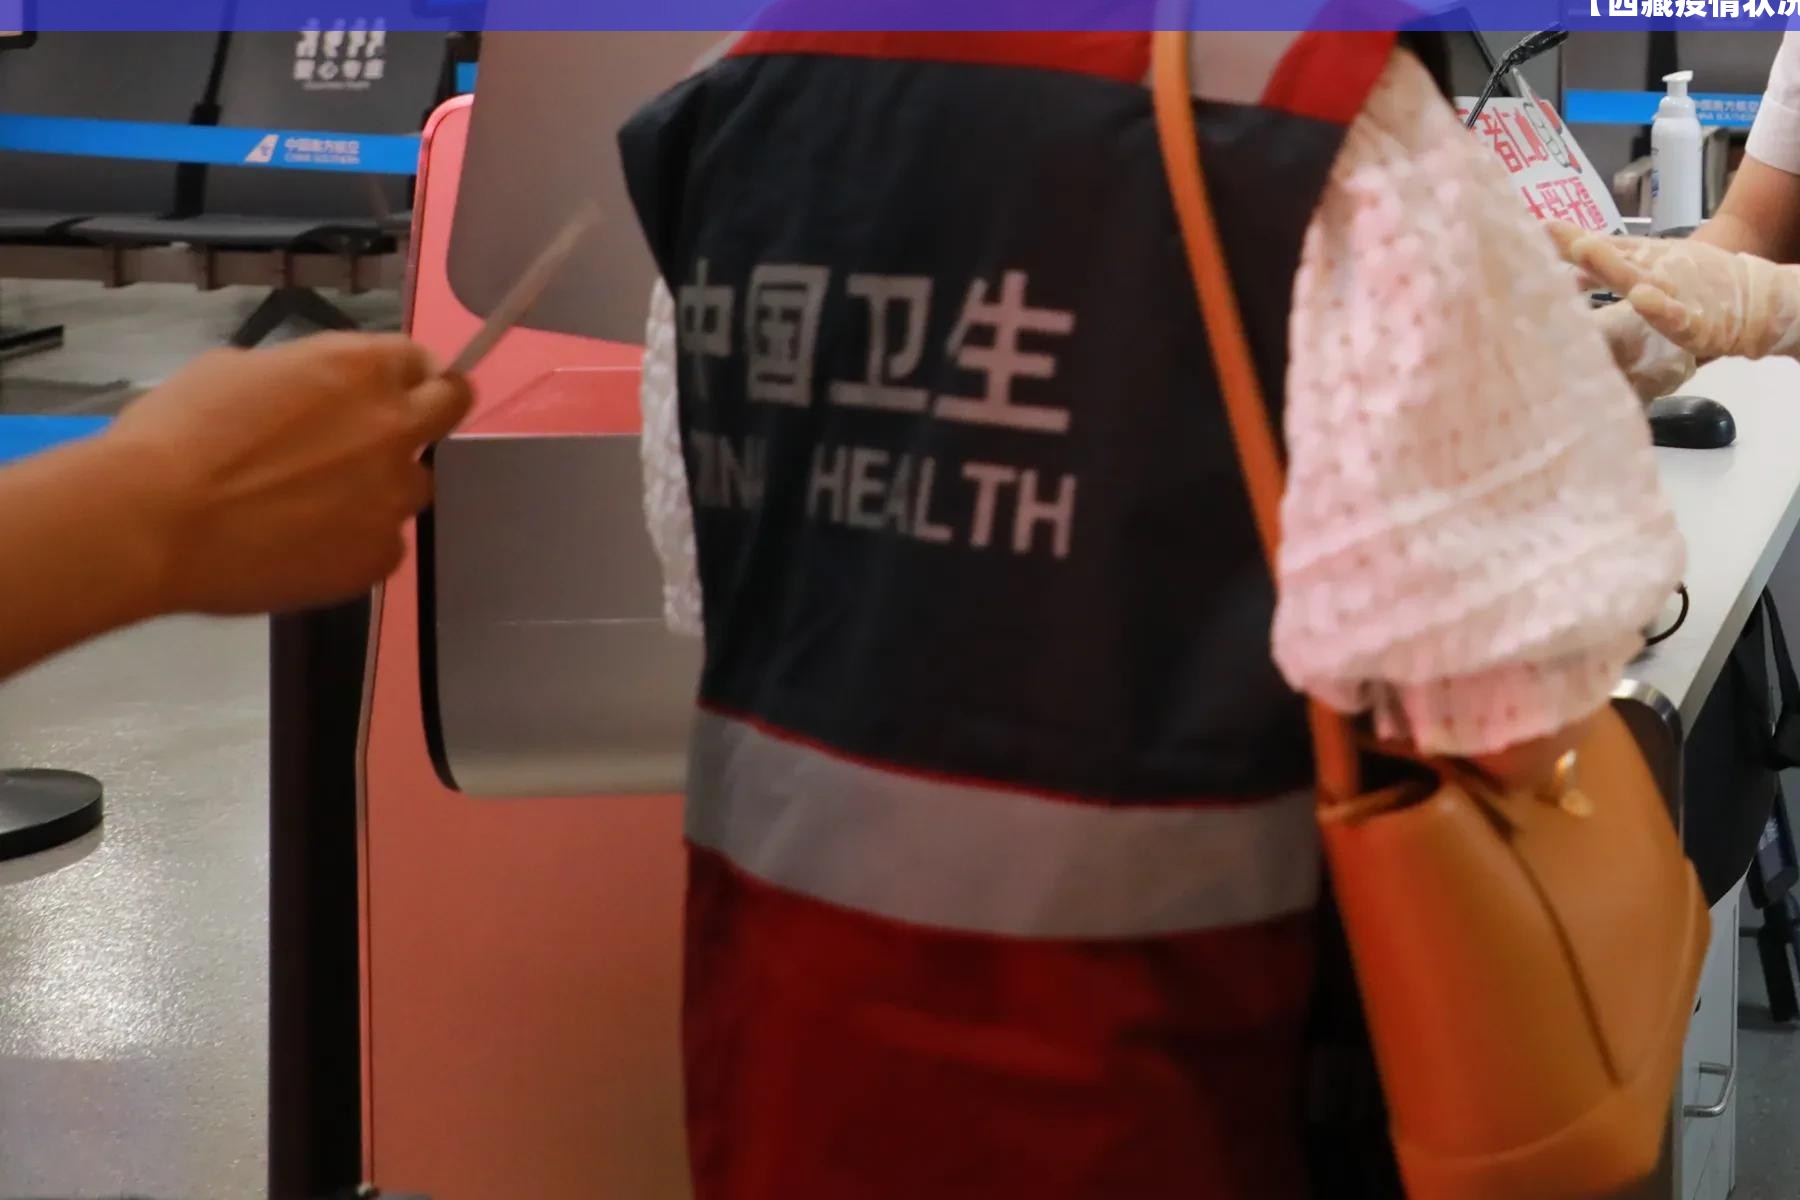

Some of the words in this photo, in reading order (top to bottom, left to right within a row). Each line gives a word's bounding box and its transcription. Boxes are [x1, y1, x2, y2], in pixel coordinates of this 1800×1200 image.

[678, 257, 1076, 434] 中国卫生
[808, 443, 1078, 560] HEALTH
